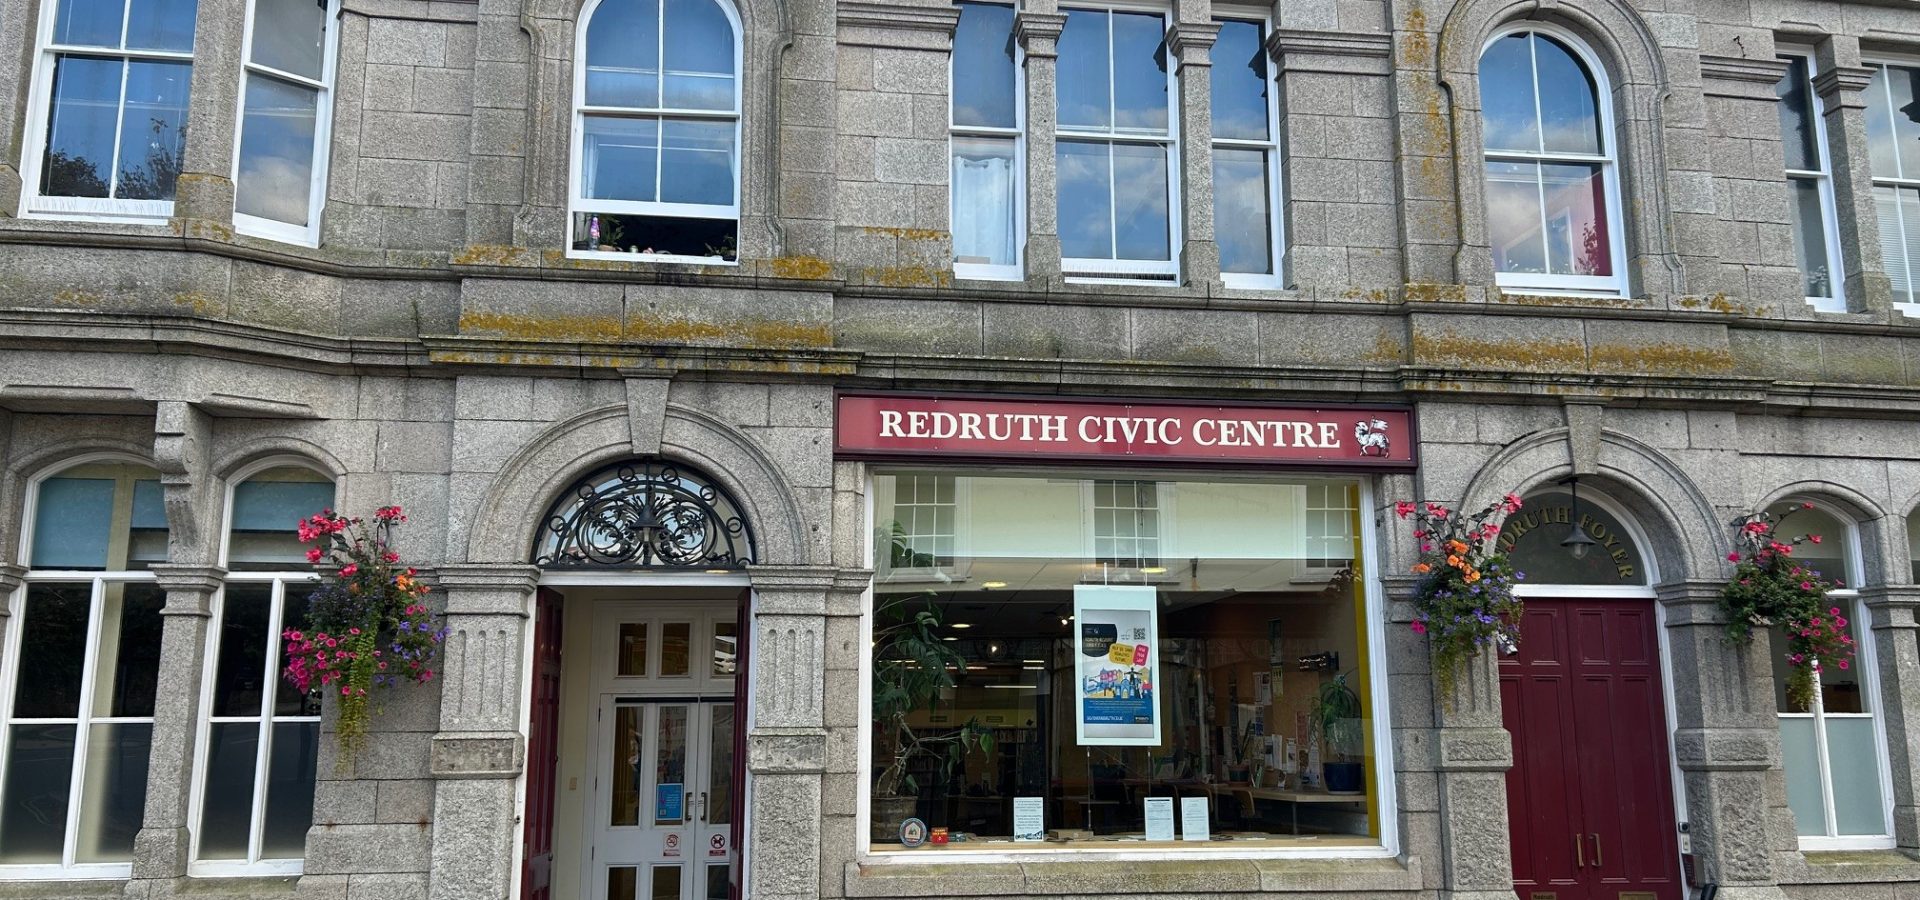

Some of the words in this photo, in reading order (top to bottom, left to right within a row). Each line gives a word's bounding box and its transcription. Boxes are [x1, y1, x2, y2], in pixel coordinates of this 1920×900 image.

[879, 410, 1068, 442] REDRUTH
[1078, 415, 1182, 446] CIVIC
[1192, 419, 1341, 449] CENTRE
[1495, 505, 1570, 552] DRUTH
[1579, 512, 1633, 579] FOYER
